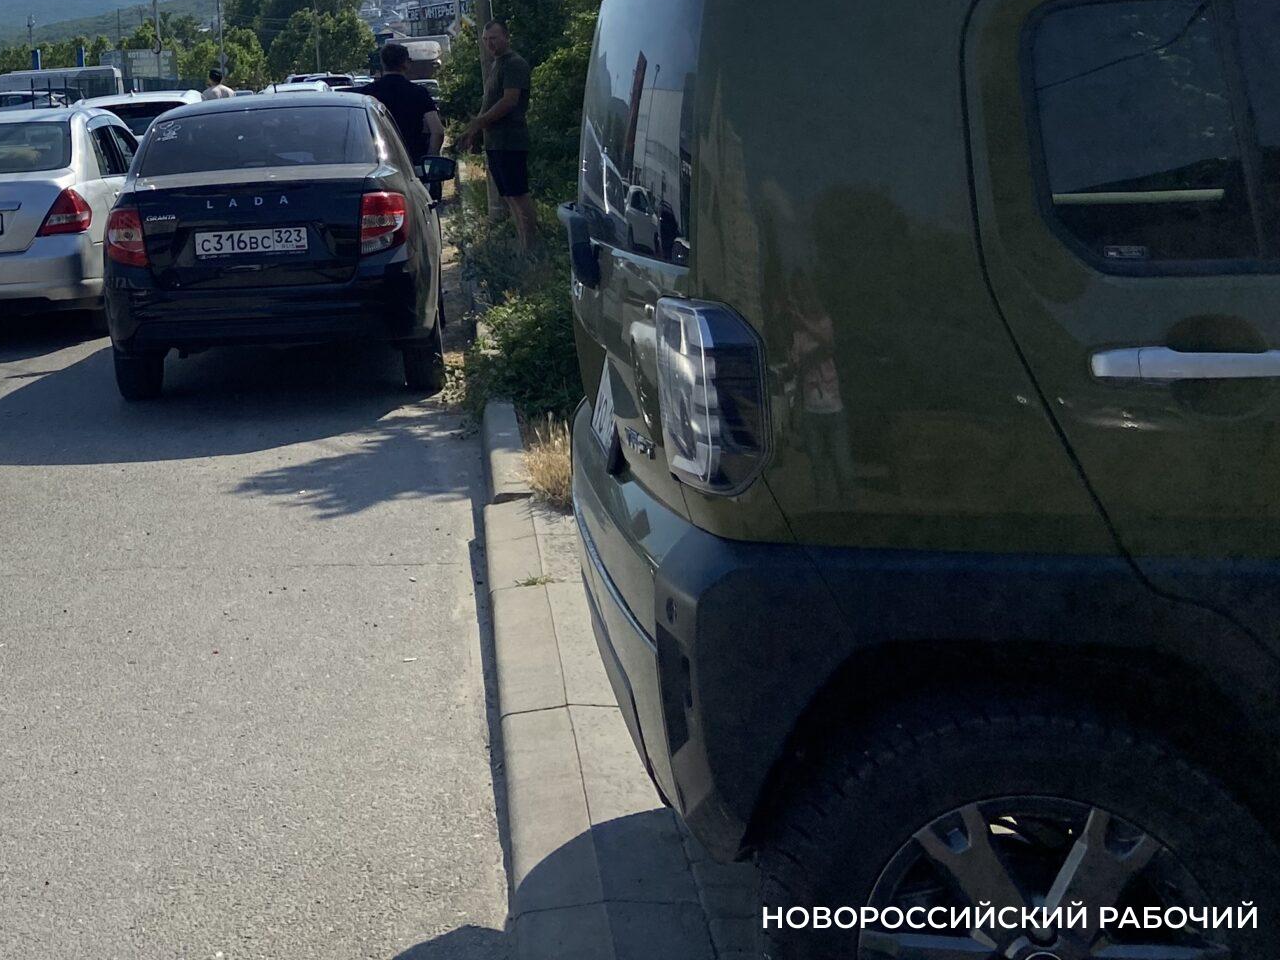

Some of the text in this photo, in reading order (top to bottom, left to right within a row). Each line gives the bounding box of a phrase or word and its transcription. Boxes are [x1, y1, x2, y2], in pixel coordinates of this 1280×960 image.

[206, 195, 288, 209] LADA
[146, 214, 176, 222] GRANTA
[201, 229, 303, 252] С316ВС 323
